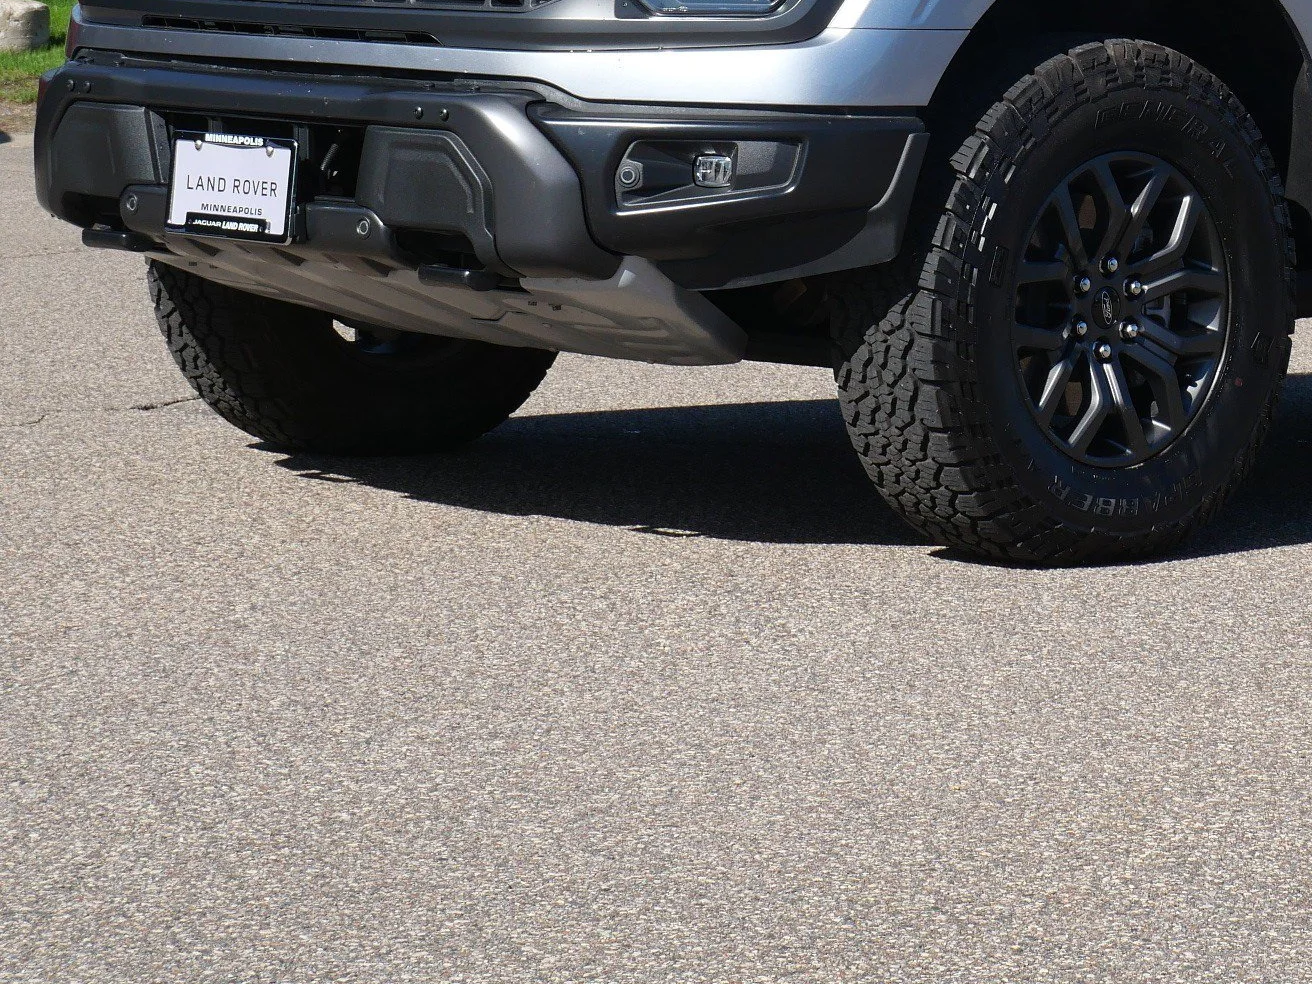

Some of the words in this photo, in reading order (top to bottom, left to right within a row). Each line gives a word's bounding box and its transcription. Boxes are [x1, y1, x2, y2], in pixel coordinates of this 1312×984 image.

[204, 133, 264, 147] MINNEAPOLIS
[186, 174, 227, 193] LAND
[232, 178, 278, 198] ROVER
[200, 202, 263, 216] MINNEAPOLIS
[192, 219, 222, 228] JAGUAR
[221, 220, 239, 231] LAND
[238, 222, 259, 233] ROVER
